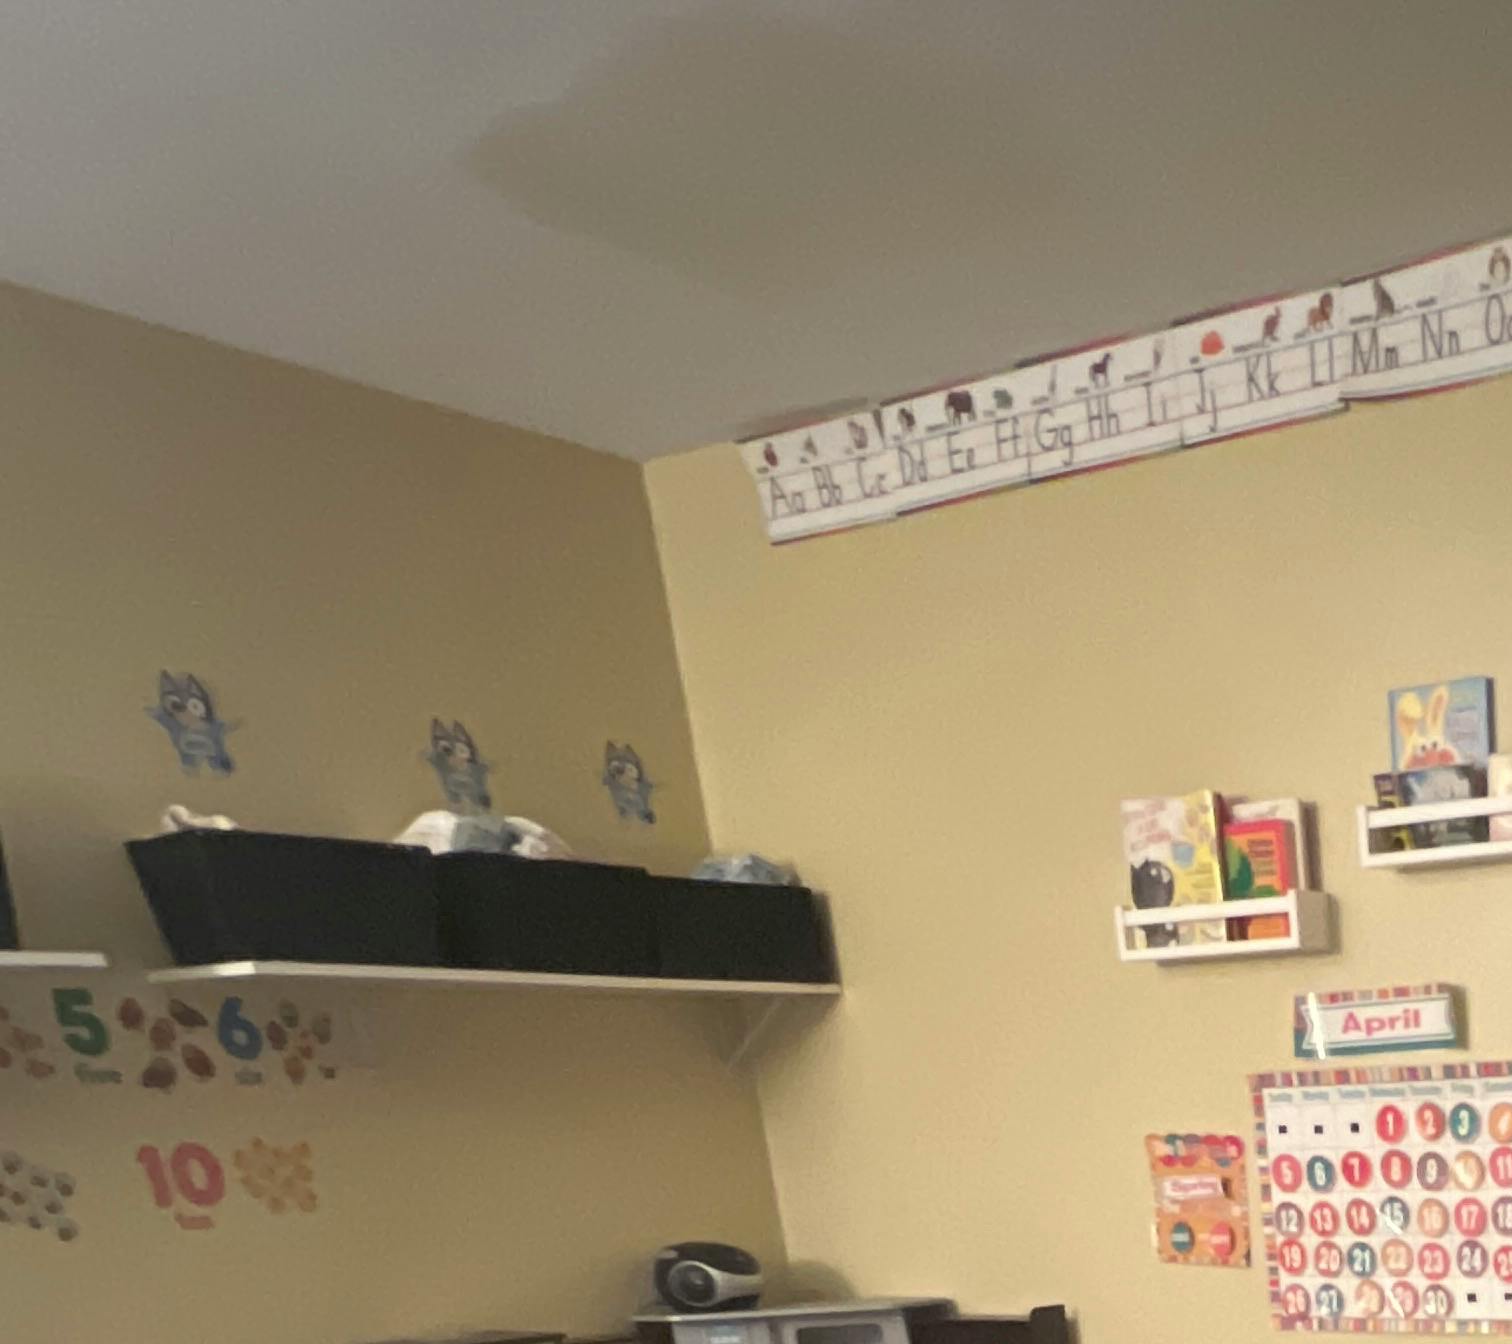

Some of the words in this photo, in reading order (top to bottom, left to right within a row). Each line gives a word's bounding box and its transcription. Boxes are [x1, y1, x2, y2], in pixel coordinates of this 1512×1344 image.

[769, 478, 805, 520] Aa
[814, 468, 843, 507] Bb
[858, 458, 888, 499] Cc
[900, 449, 929, 489] Dd
[948, 431, 978, 474] Ee
[994, 420, 1024, 464] Ff
[1034, 411, 1074, 466] Gg
[1088, 399, 1121, 441] Hh
[1192, 369, 1220, 432] Jj
[1245, 354, 1282, 400] Kk
[1310, 336, 1337, 388] Ll
[1352, 327, 1399, 376] Mm
[1421, 318, 1460, 363] Nn
[52, 988, 111, 1056] 5
[217, 996, 263, 1060] 6
[1342, 1009, 1421, 1037] April
[1424, 1109, 1436, 1135] 2
[1457, 1109, 1470, 1136] 3
[136, 1141, 225, 1208] 10
[1281, 1160, 1295, 1184] 5
[1314, 1161, 1328, 1186] 6
[1349, 1157, 1361, 1182] 7
[1280, 1209, 1299, 1233] 12
[1313, 1208, 1333, 1232] 13
[1352, 1206, 1371, 1230] 14
[1461, 1205, 1479, 1229] 17
[1284, 1245, 1301, 1268] 19
[1319, 1247, 1341, 1271] 20
[1353, 1248, 1371, 1273] 21
[1461, 1246, 1482, 1270] 24
